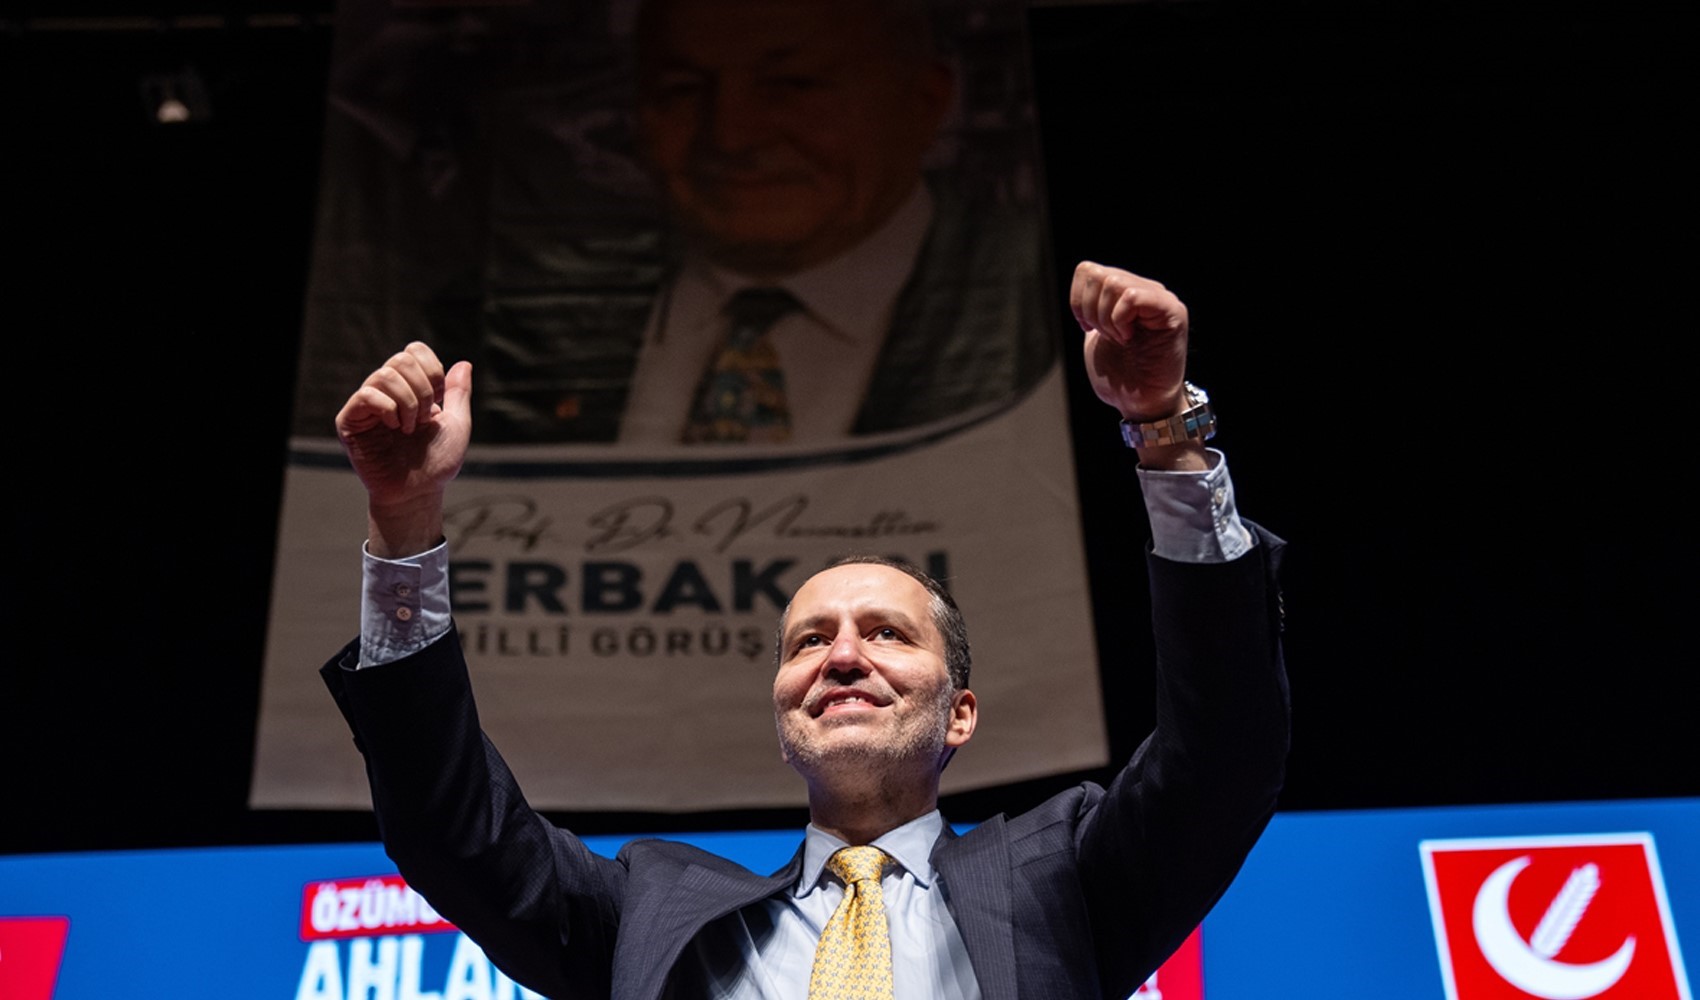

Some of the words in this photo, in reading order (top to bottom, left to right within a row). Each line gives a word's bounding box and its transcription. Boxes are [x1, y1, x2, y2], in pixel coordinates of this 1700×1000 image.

[449, 550, 949, 614] ERBAK
[459, 622, 570, 657] İLLİ
[592, 620, 764, 663] GÖRÜŞ
[310, 879, 446, 932] ÖZÜM
